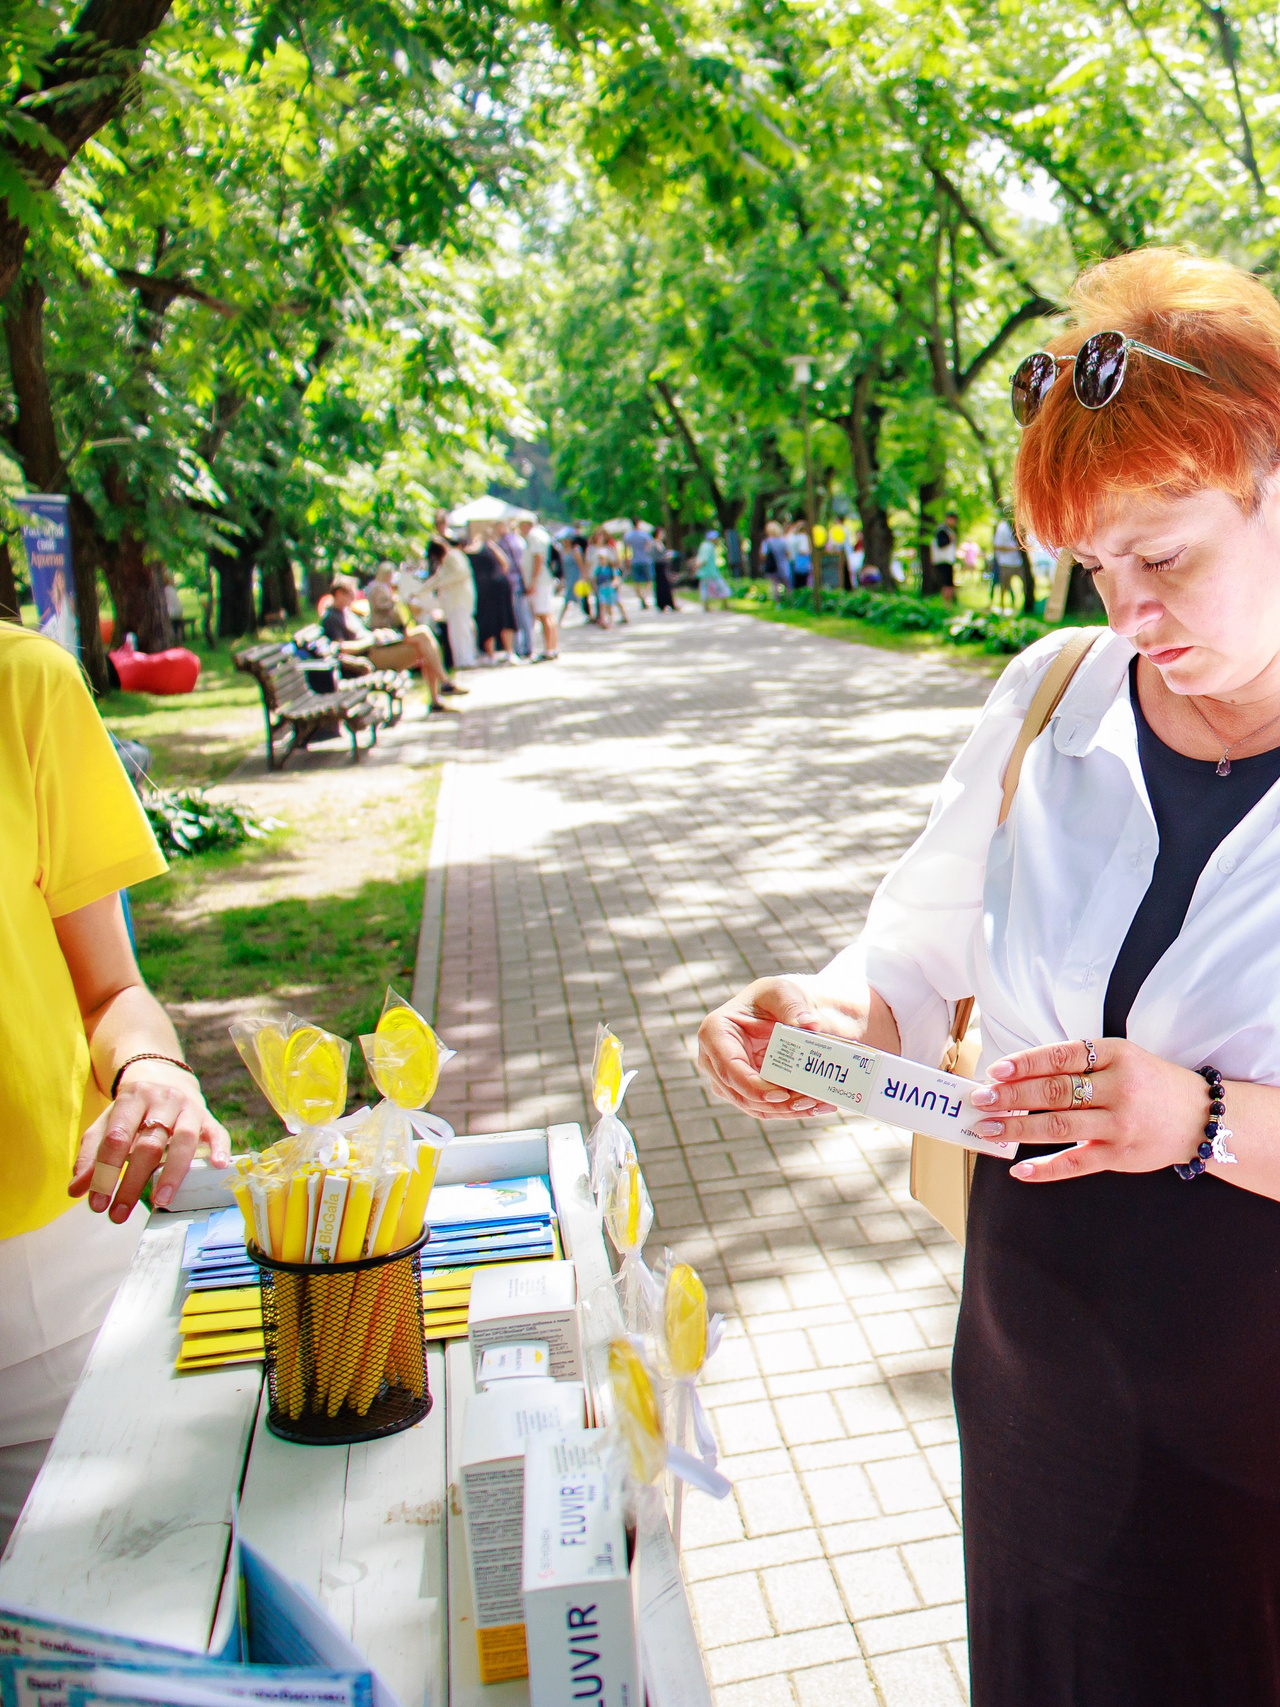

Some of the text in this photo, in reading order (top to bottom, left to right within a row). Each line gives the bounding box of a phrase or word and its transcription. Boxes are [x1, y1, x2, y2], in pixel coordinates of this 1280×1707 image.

[804, 1055, 849, 1083] FLUVIR
[883, 1077, 962, 1118] FLUVIR
[319, 1193, 340, 1244] BioGaia
[560, 1484, 586, 1546] FLUVIR
[567, 1603, 603, 1707] UVIR
